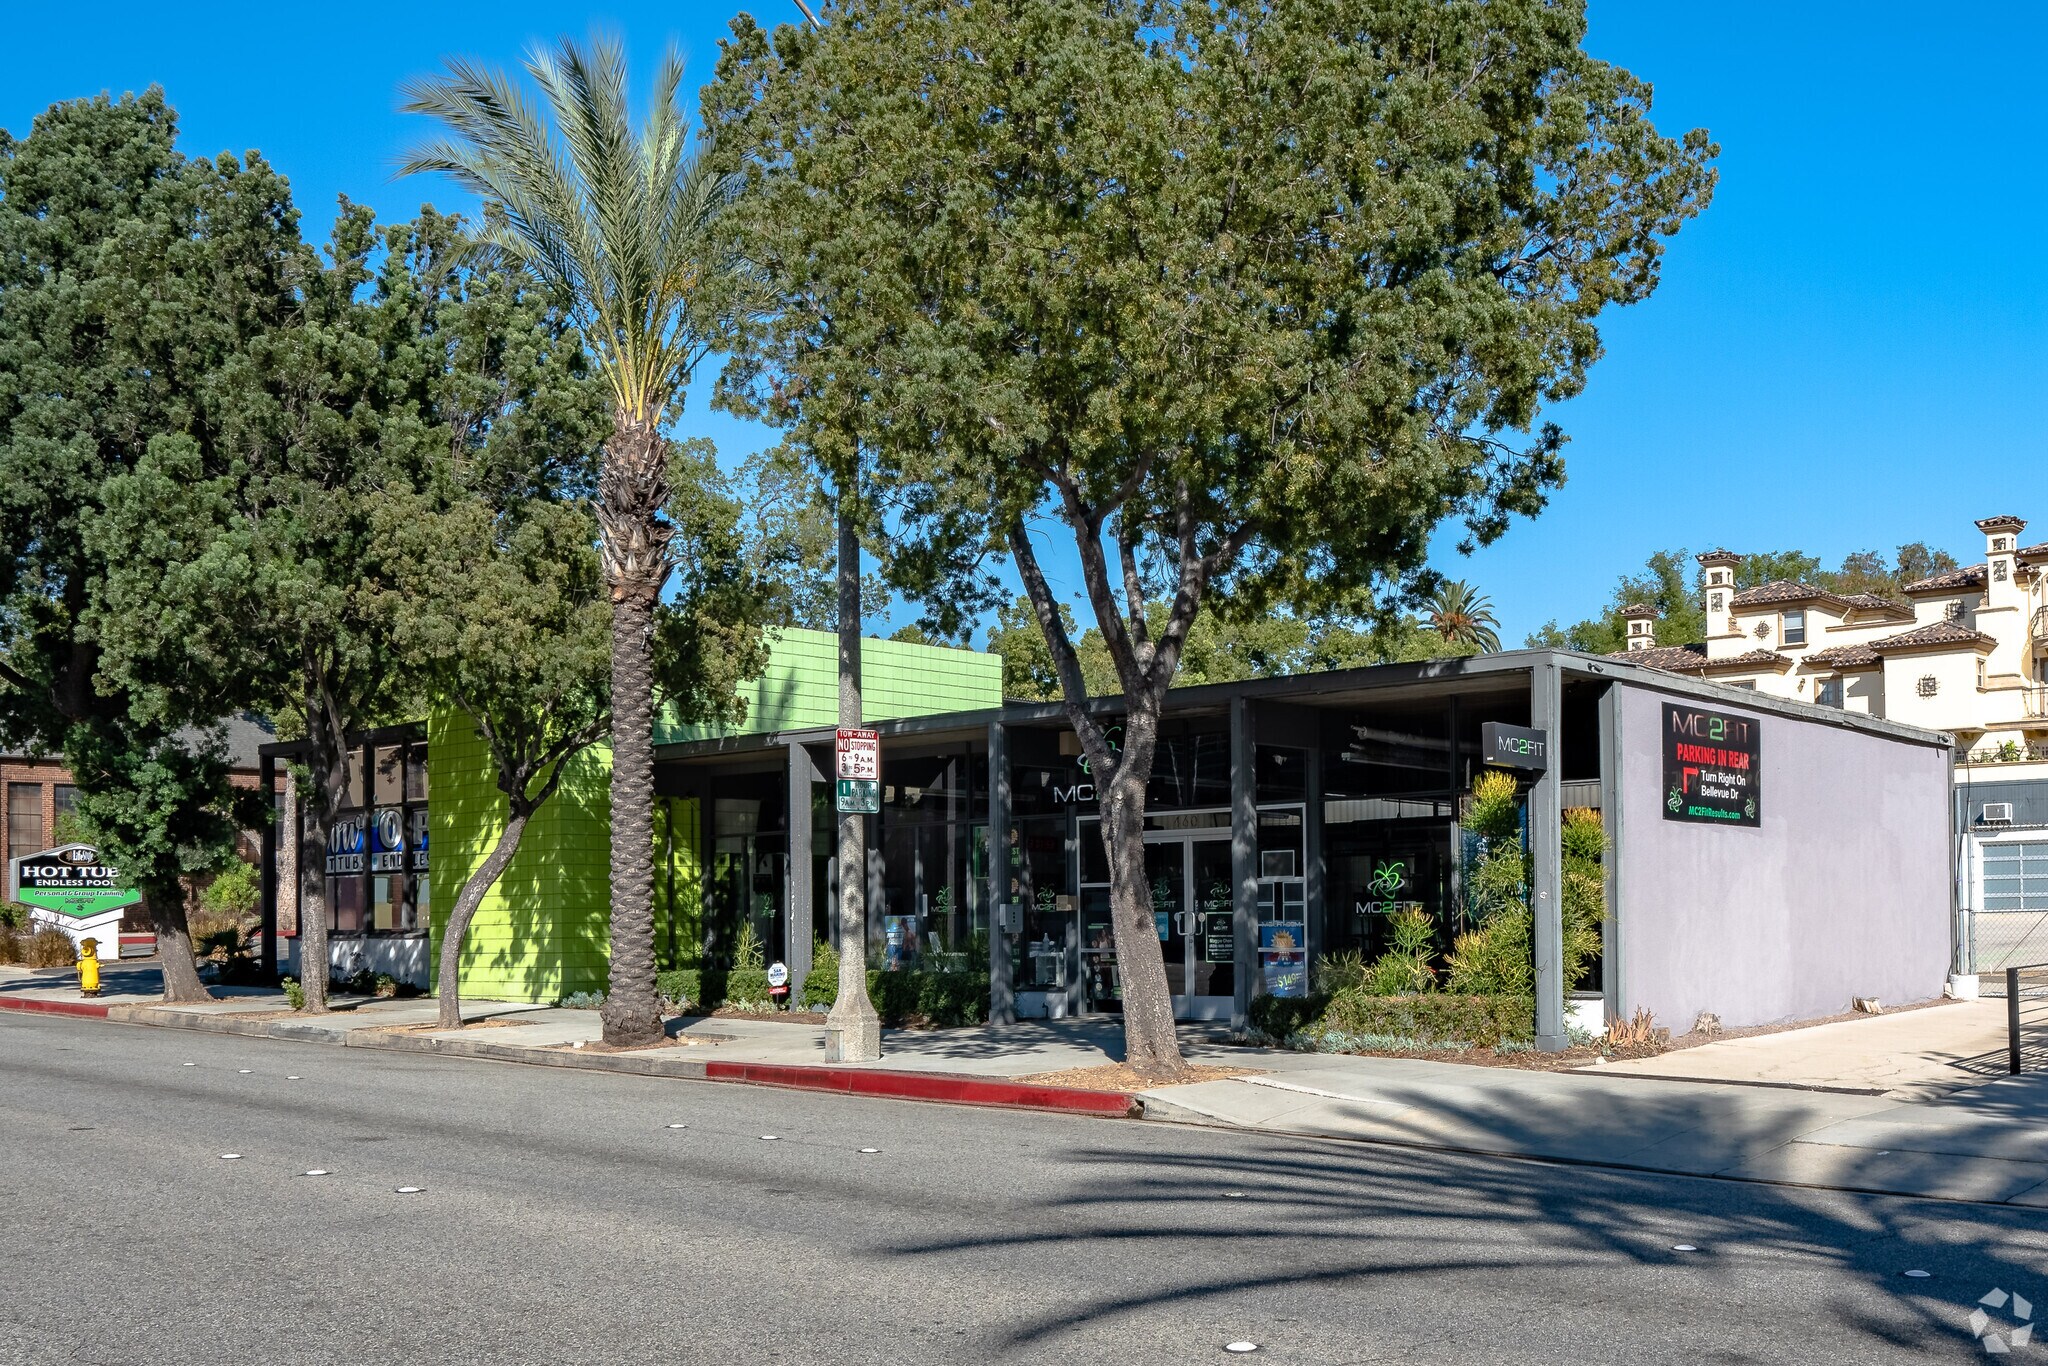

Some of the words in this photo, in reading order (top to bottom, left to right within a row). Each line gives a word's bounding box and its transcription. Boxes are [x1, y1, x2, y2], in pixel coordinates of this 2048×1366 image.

[1673, 711, 1749, 743] MC2FIT
[840, 730, 875, 738] TOW-AWAY
[838, 738, 849, 751] NO
[851, 741, 876, 751] STOPPING
[1498, 736, 1545, 757] MC2FIT
[841, 753, 847, 762] 6
[1677, 743, 1716, 765] PARKING
[1718, 749, 1727, 767] IN
[1729, 750, 1750, 770] REAR
[841, 763, 847, 772] 3
[1701, 770, 1717, 783] Turn
[1718, 772, 1736, 787] Right
[1736, 775, 1746, 787] On
[1701, 785, 1730, 799] Bellevue
[1730, 789, 1739, 800] Dr
[1688, 806, 1740, 820] MC2FitResults.com
[22, 866, 72, 878] HOT
[76, 866, 120, 878] TUB
[1356, 901, 1417, 914] MC2FIT
